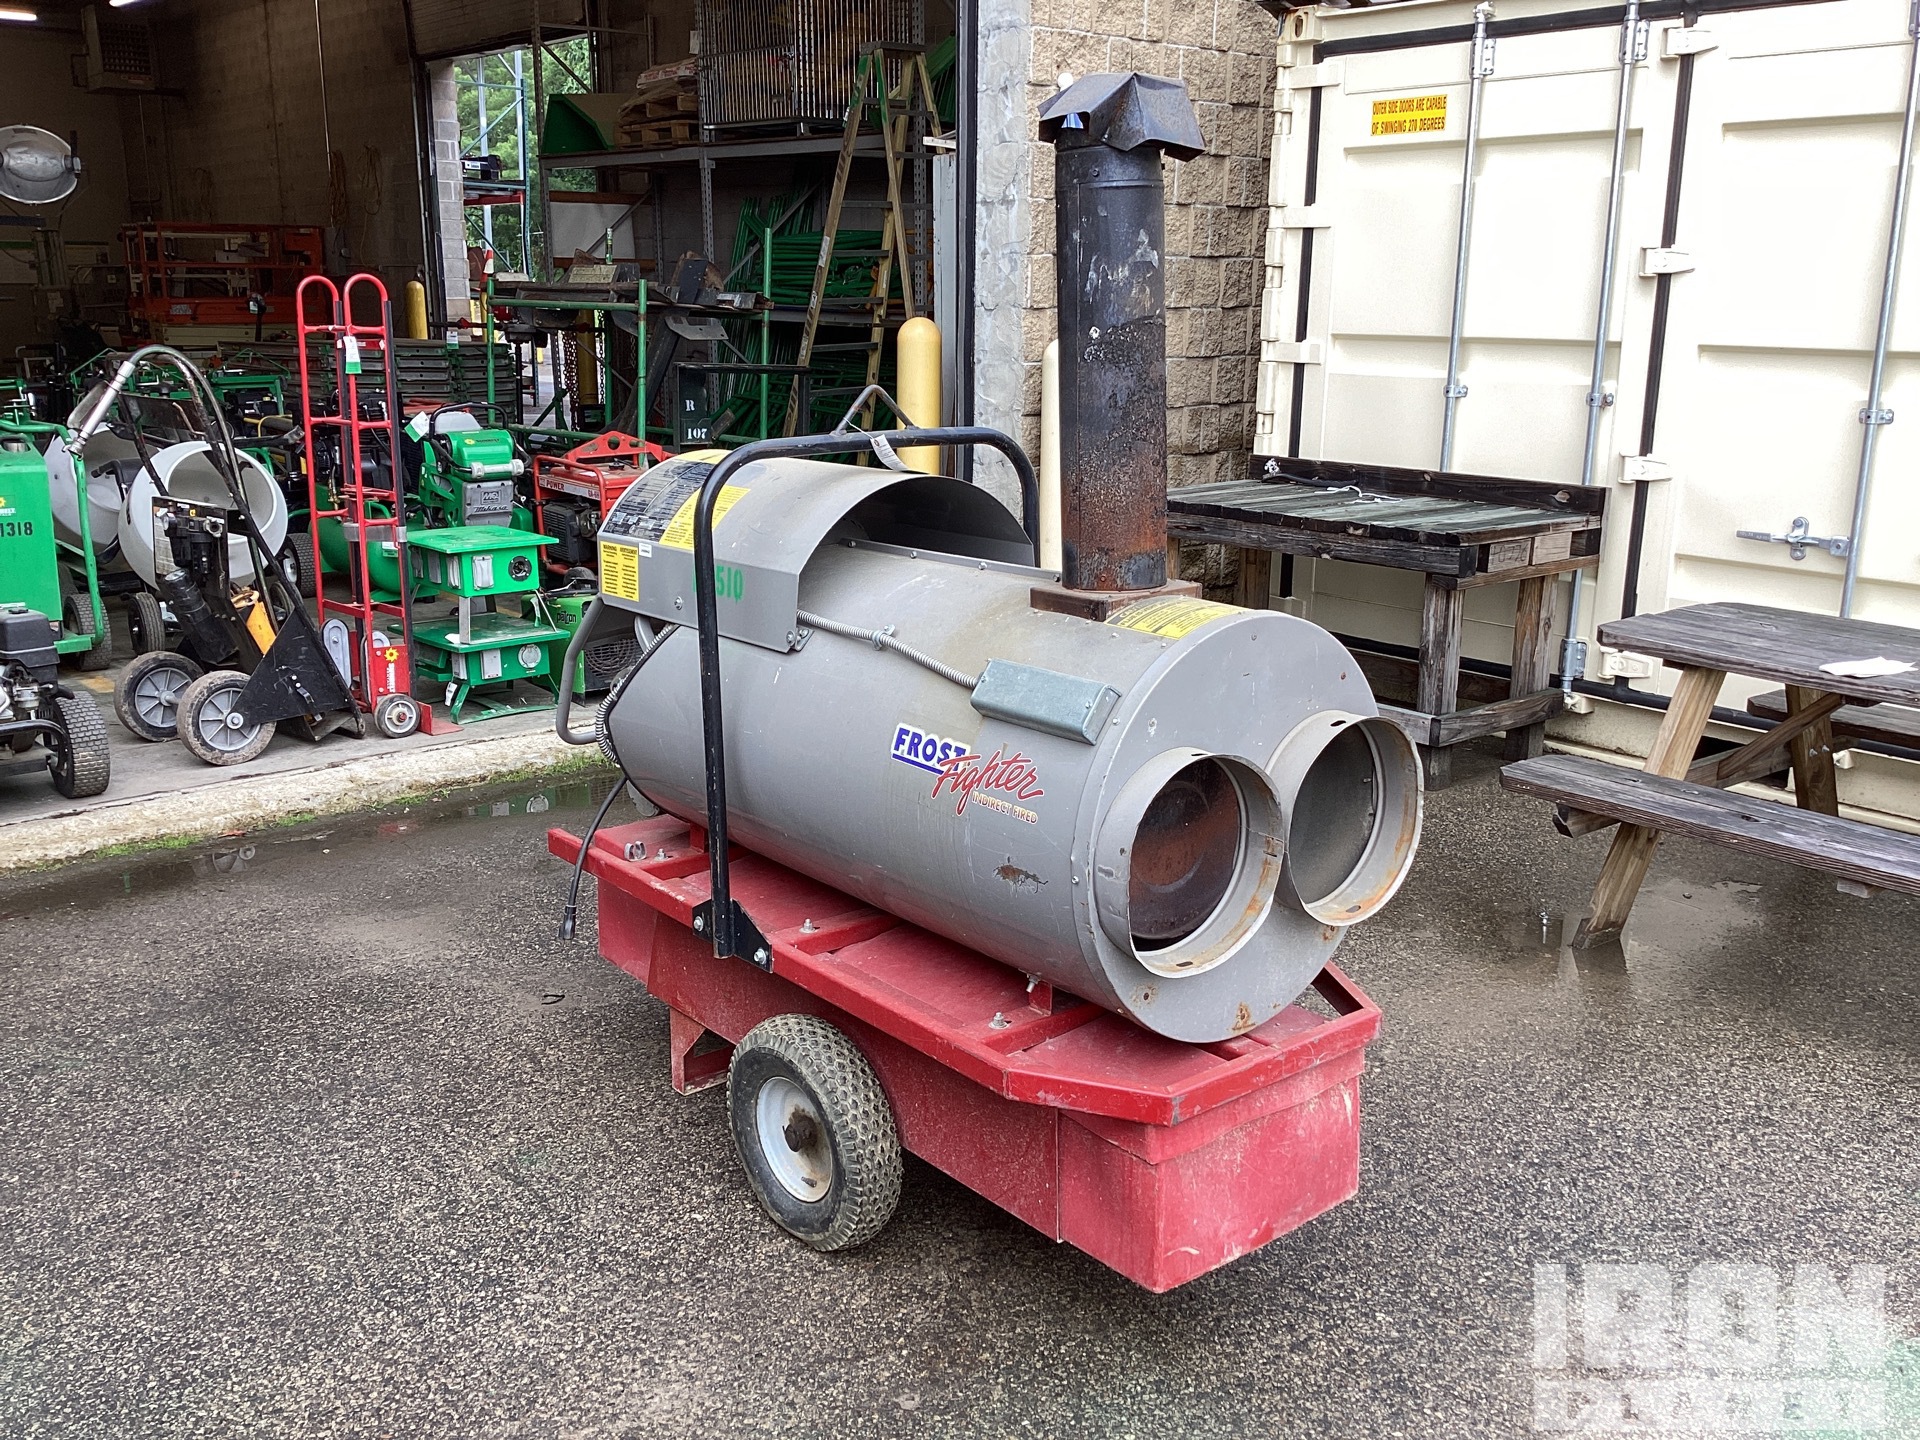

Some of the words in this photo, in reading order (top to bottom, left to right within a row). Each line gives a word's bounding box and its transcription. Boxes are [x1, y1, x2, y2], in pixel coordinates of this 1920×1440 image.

[1372, 101, 1387, 115] OUTER
[1388, 100, 1398, 114] SIDE
[1399, 99, 1415, 113] DOORS
[1416, 98, 1425, 112] ARE
[1425, 96, 1447, 110] CAPABLE
[1371, 121, 1379, 135] OF
[1380, 119, 1407, 134] SWINGING
[1408, 118, 1418, 132] 270
[1418, 116, 1445, 131] DEGREES
[685, 399, 695, 412] R
[687, 427, 708, 440] 107
[546, 479, 565, 491] POWER
[893, 727, 967, 776] FROST
[931, 750, 1044, 816] Fighter
[971, 790, 1013, 816] INDIRECT
[1012, 804, 1038, 825] FIRED
